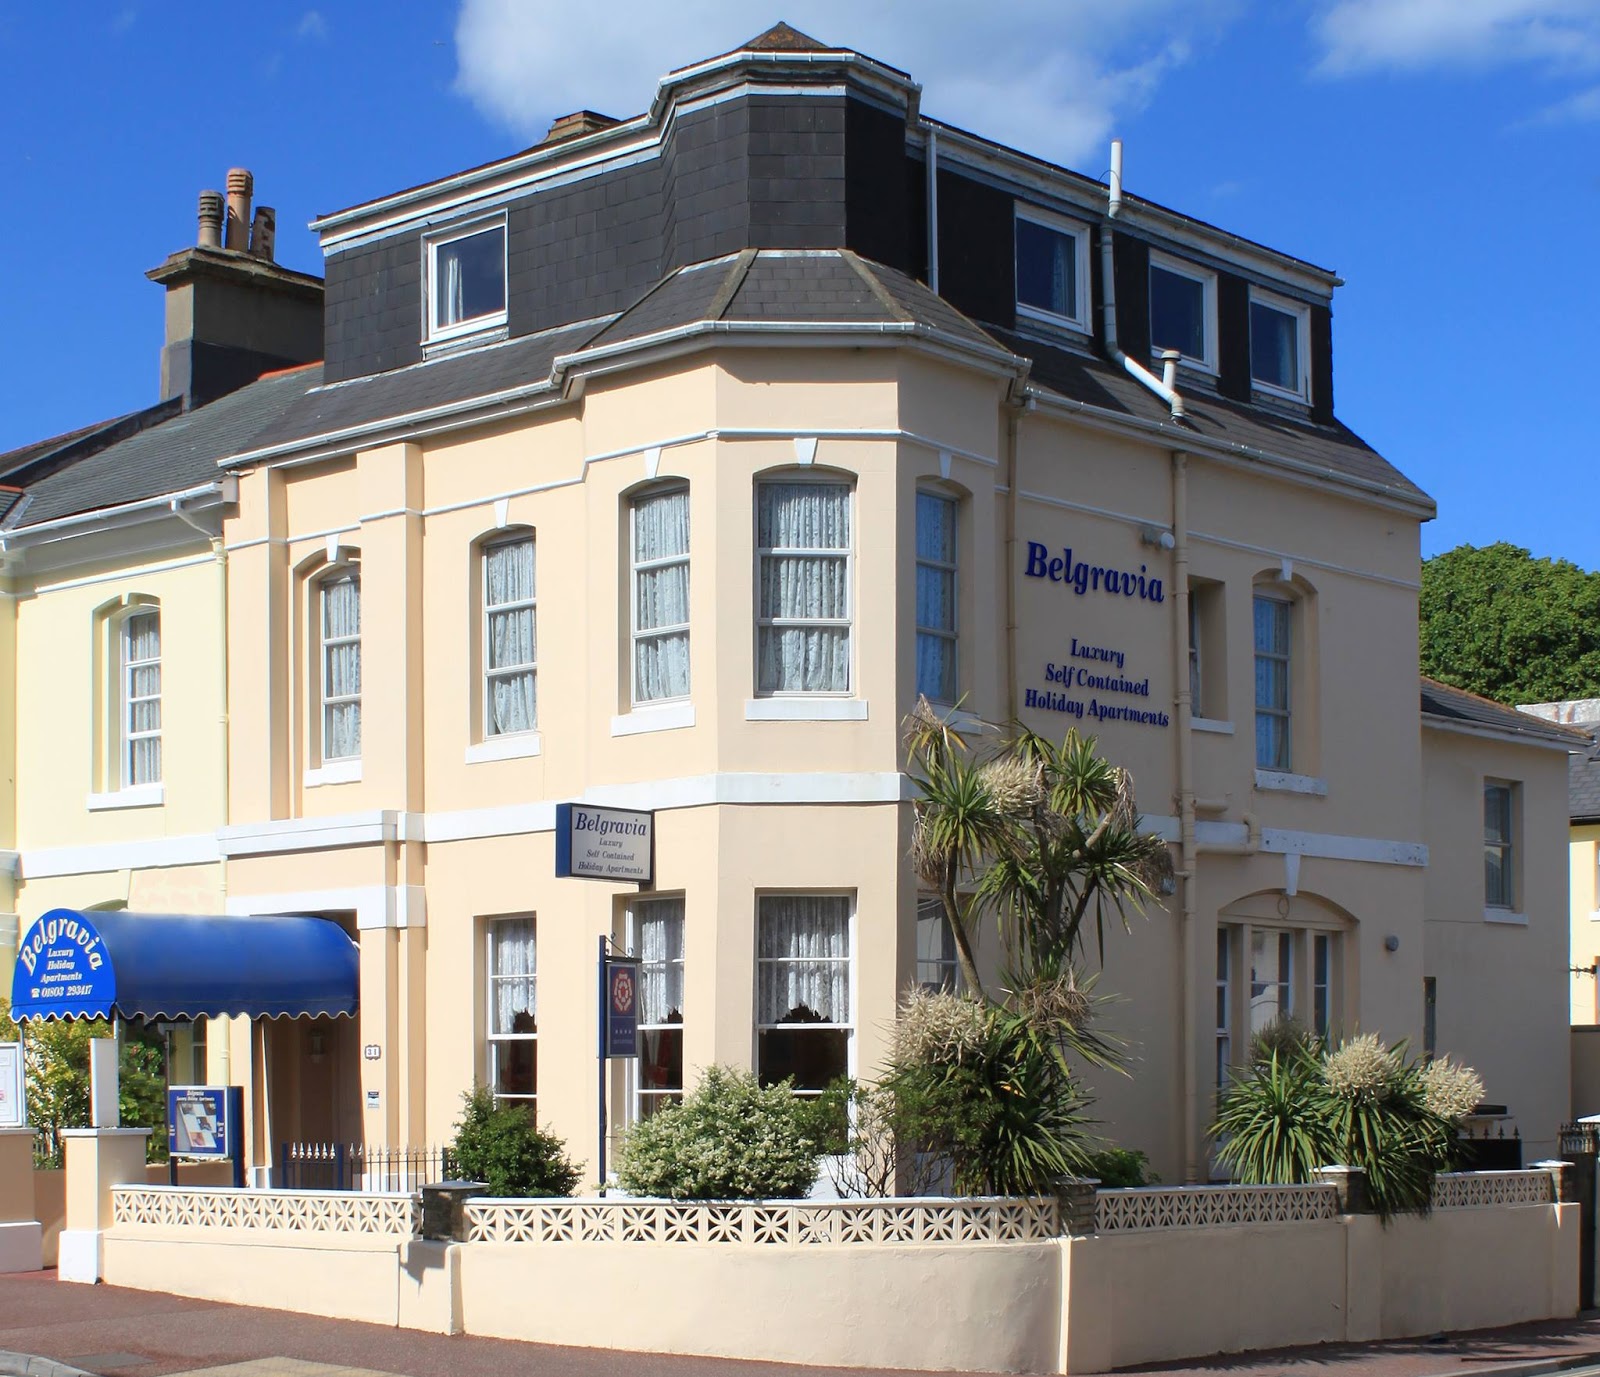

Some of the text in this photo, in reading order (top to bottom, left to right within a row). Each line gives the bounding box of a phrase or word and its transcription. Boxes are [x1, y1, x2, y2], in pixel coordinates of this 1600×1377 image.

[1025, 541, 1164, 603] Belgravia
[1070, 638, 1125, 668] Luxury
[1045, 663, 1149, 697] Self Contained
[1025, 688, 1169, 727] Holiday Apartments
[575, 812, 647, 836] Belgravia
[599, 838, 623, 848] Luxury
[586, 849, 635, 861] Self Contained
[578, 861, 644, 874] Holiday Apartments
[21, 918, 103, 977] Belgravia
[47, 948, 74, 958] Luxury
[46, 960, 75, 970] Holiday
[41, 972, 83, 984] Apartments
